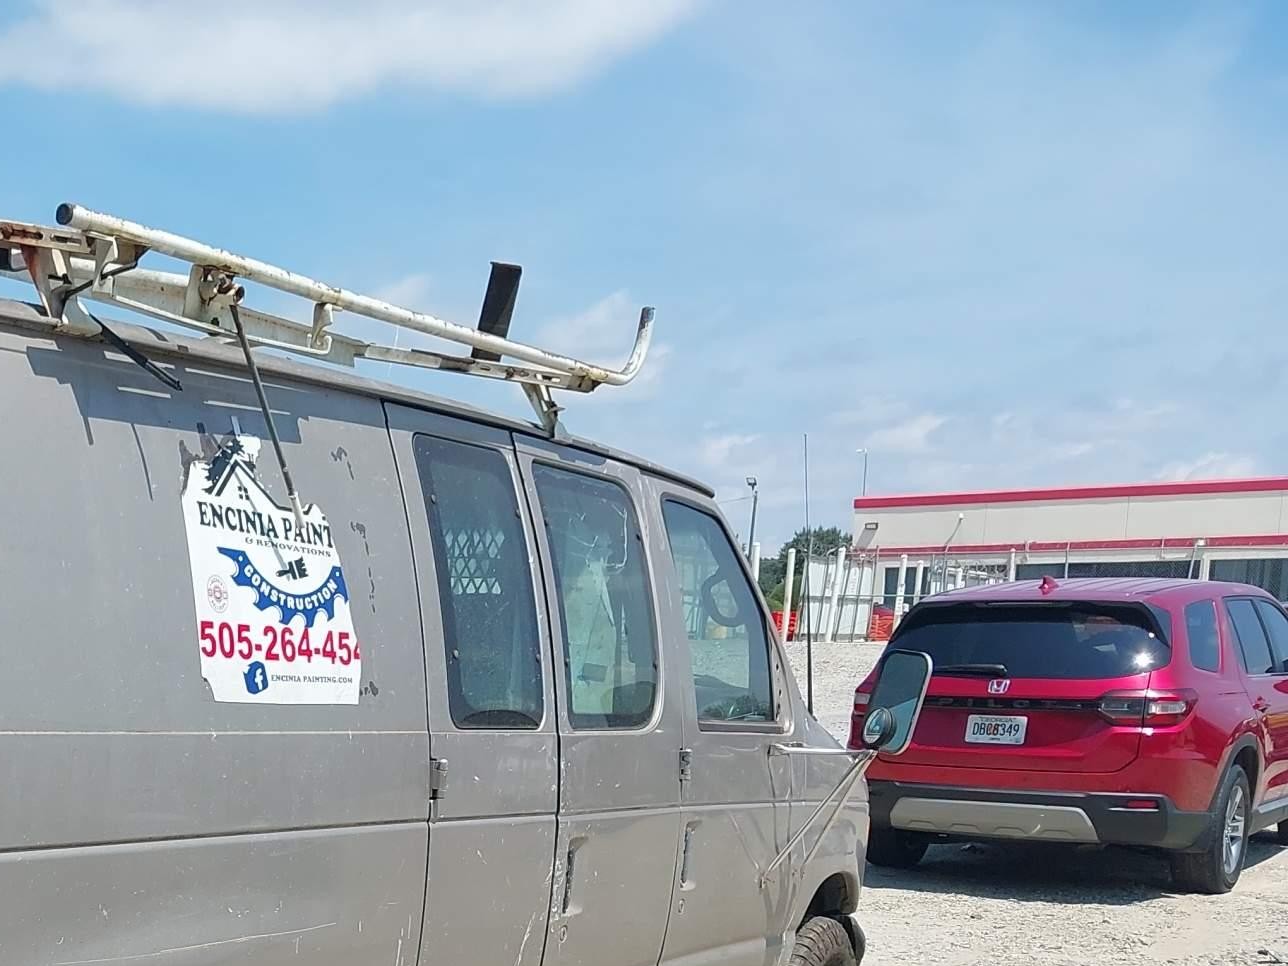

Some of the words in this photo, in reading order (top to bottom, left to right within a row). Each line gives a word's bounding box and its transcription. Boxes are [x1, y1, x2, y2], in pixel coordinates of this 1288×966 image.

[197, 501, 279, 538] ENCINIA
[256, 540, 332, 558] RENOVATIONS
[244, 565, 338, 610] CONSTRUCTION
[271, 674, 301, 683] ENCINIA
[303, 675, 353, 684] PAINTING.COM
[937, 698, 1058, 709] PILOT
